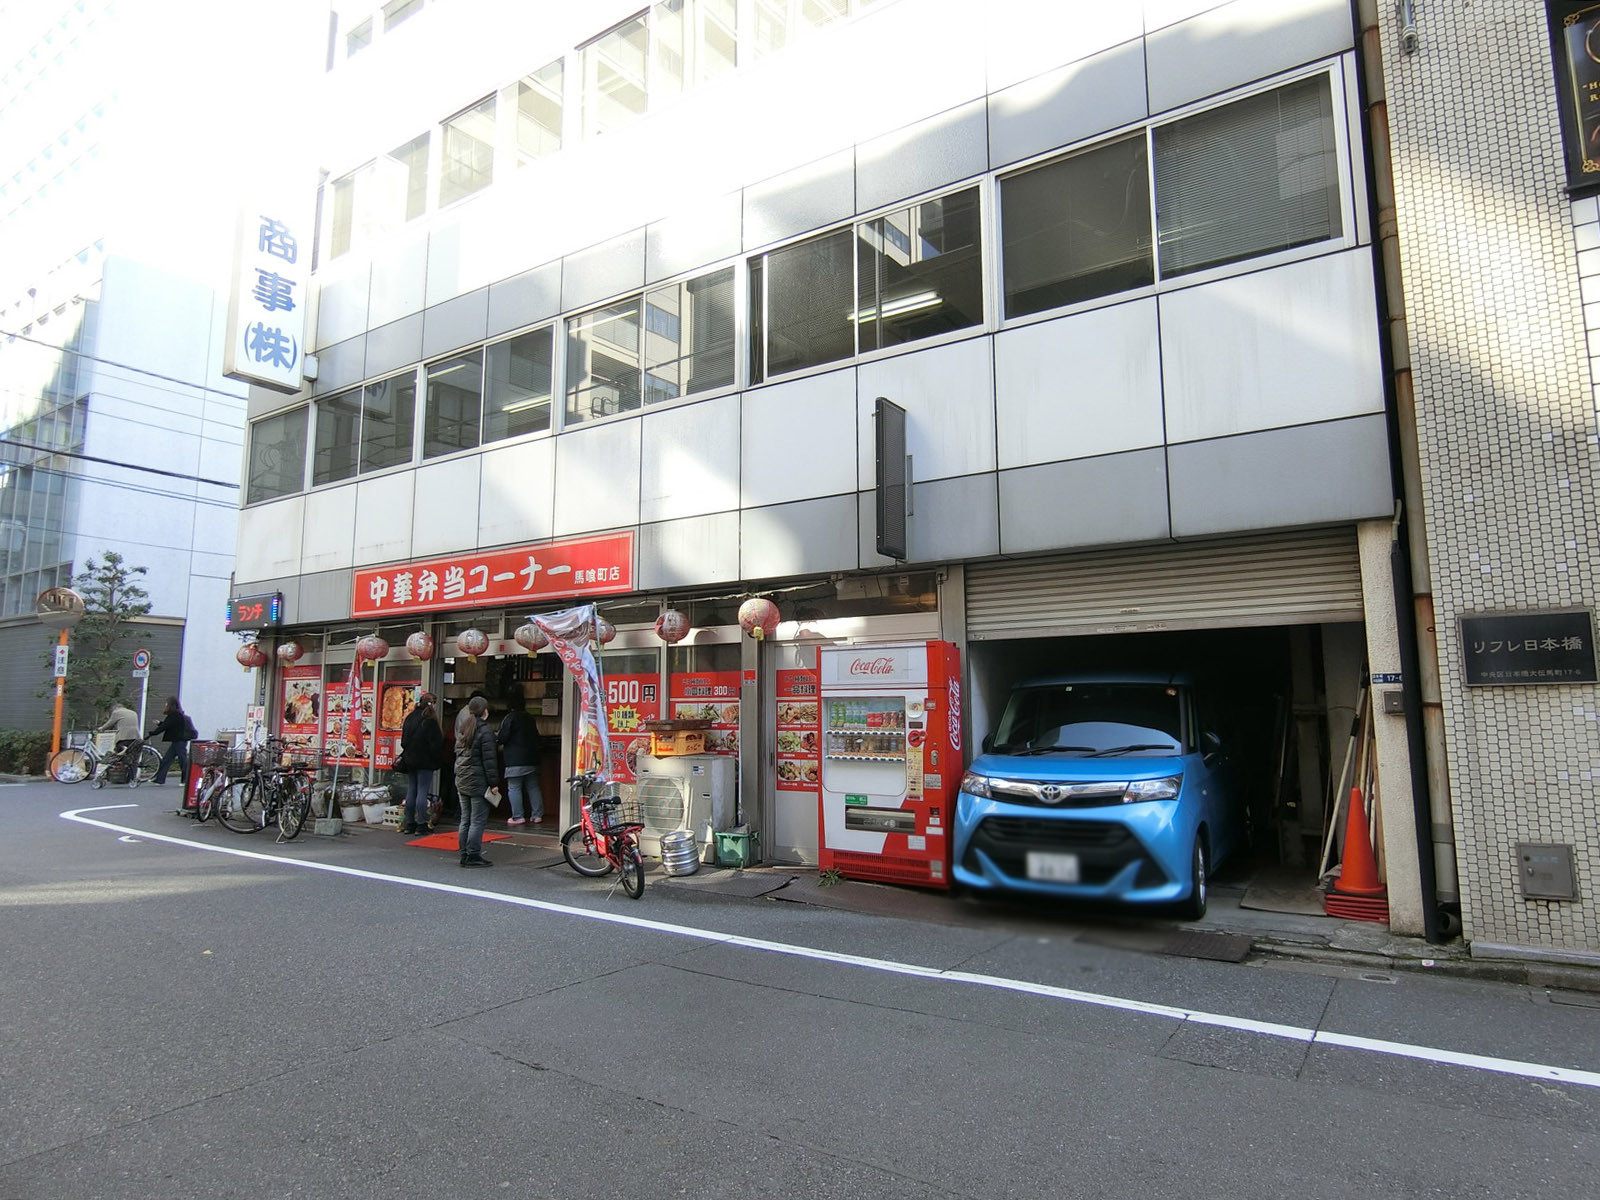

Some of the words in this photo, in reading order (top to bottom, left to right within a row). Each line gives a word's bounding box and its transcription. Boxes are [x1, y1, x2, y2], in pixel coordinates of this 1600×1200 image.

[370, 555, 571, 607] 中華弁当コーナー
[573, 566, 621, 584] 馬喰町店
[238, 603, 264, 622] ランチ
[1474, 636, 1583, 654] リフレ日本橋
[850, 657, 895, 676] Coca-Cola
